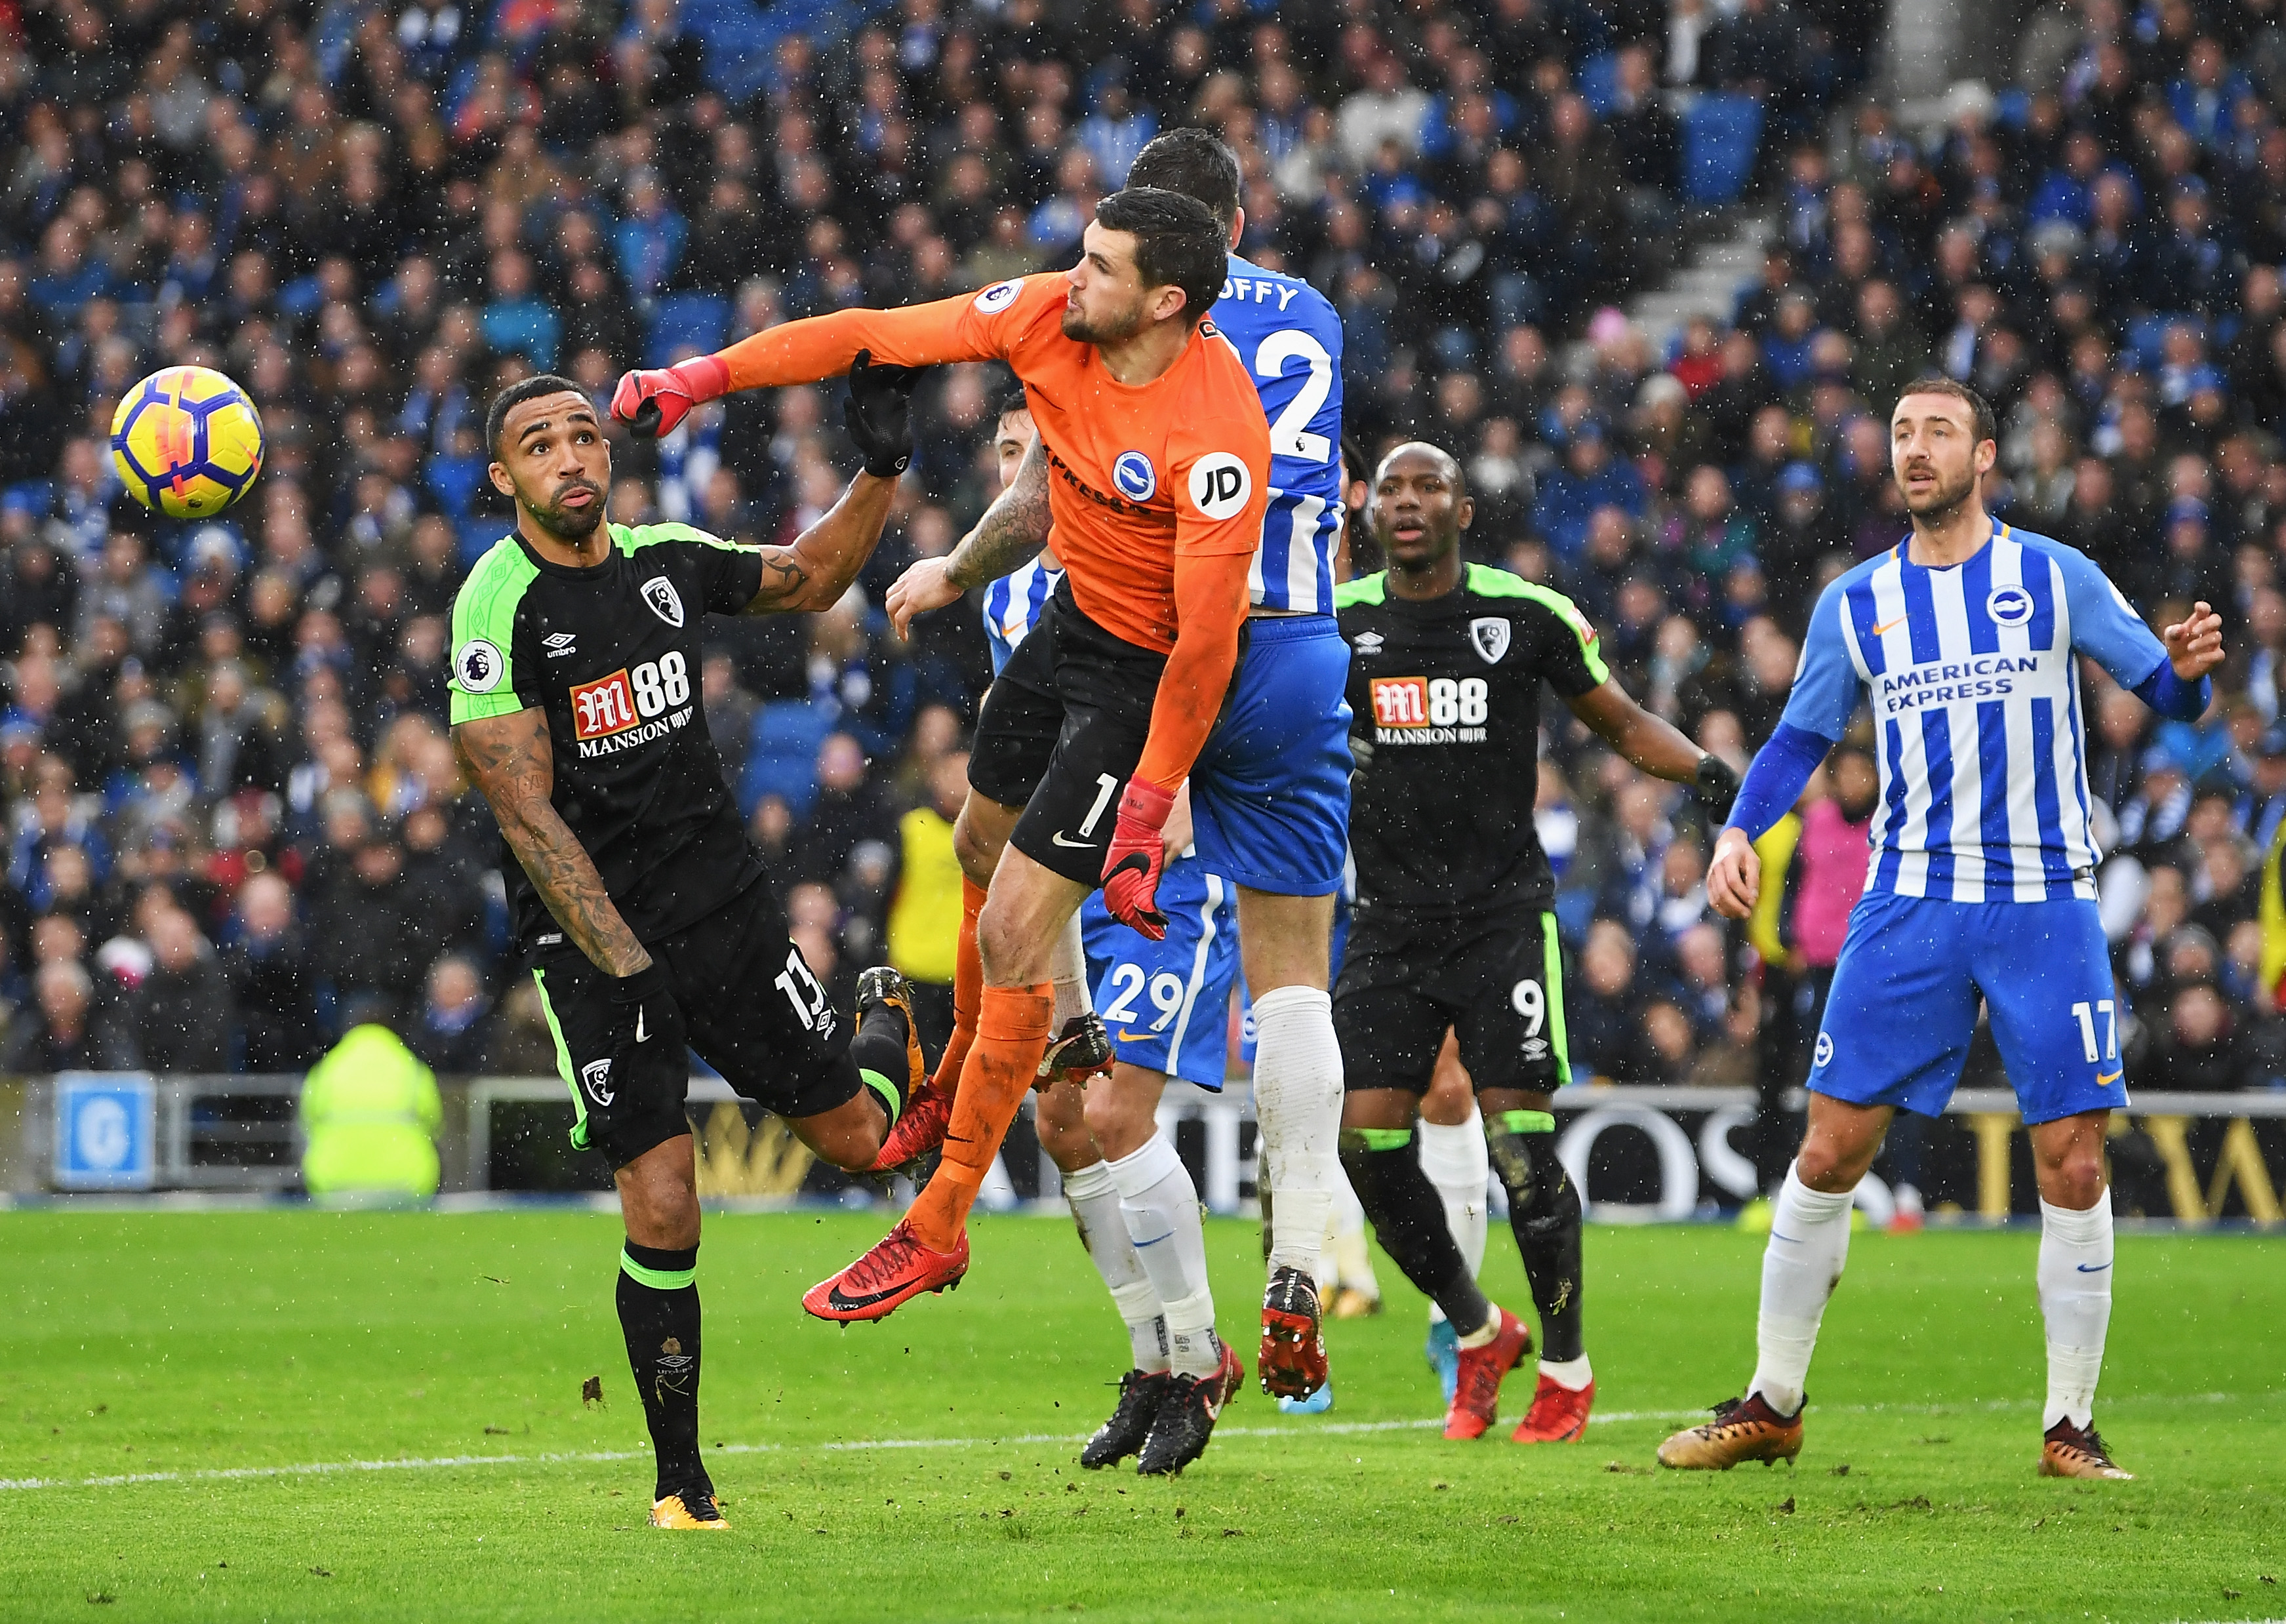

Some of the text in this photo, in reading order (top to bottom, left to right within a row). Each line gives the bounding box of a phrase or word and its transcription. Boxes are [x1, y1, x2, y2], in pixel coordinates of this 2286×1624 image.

[1217, 328, 1333, 464] 2
[1200, 465, 1242, 507] JD
[547, 646, 576, 658] umbro
[1883, 656, 2038, 694] AMERICAN
[1887, 678, 2014, 713] EXPRESS
[578, 717, 670, 759] MANSION
[1376, 727, 1457, 745] MANSION
[1078, 772, 1119, 838] 1
[774, 948, 824, 1031] 13
[1102, 962, 1184, 1032] 29
[1511, 978, 1545, 1038] 9
[2072, 999, 2117, 1063] 17
